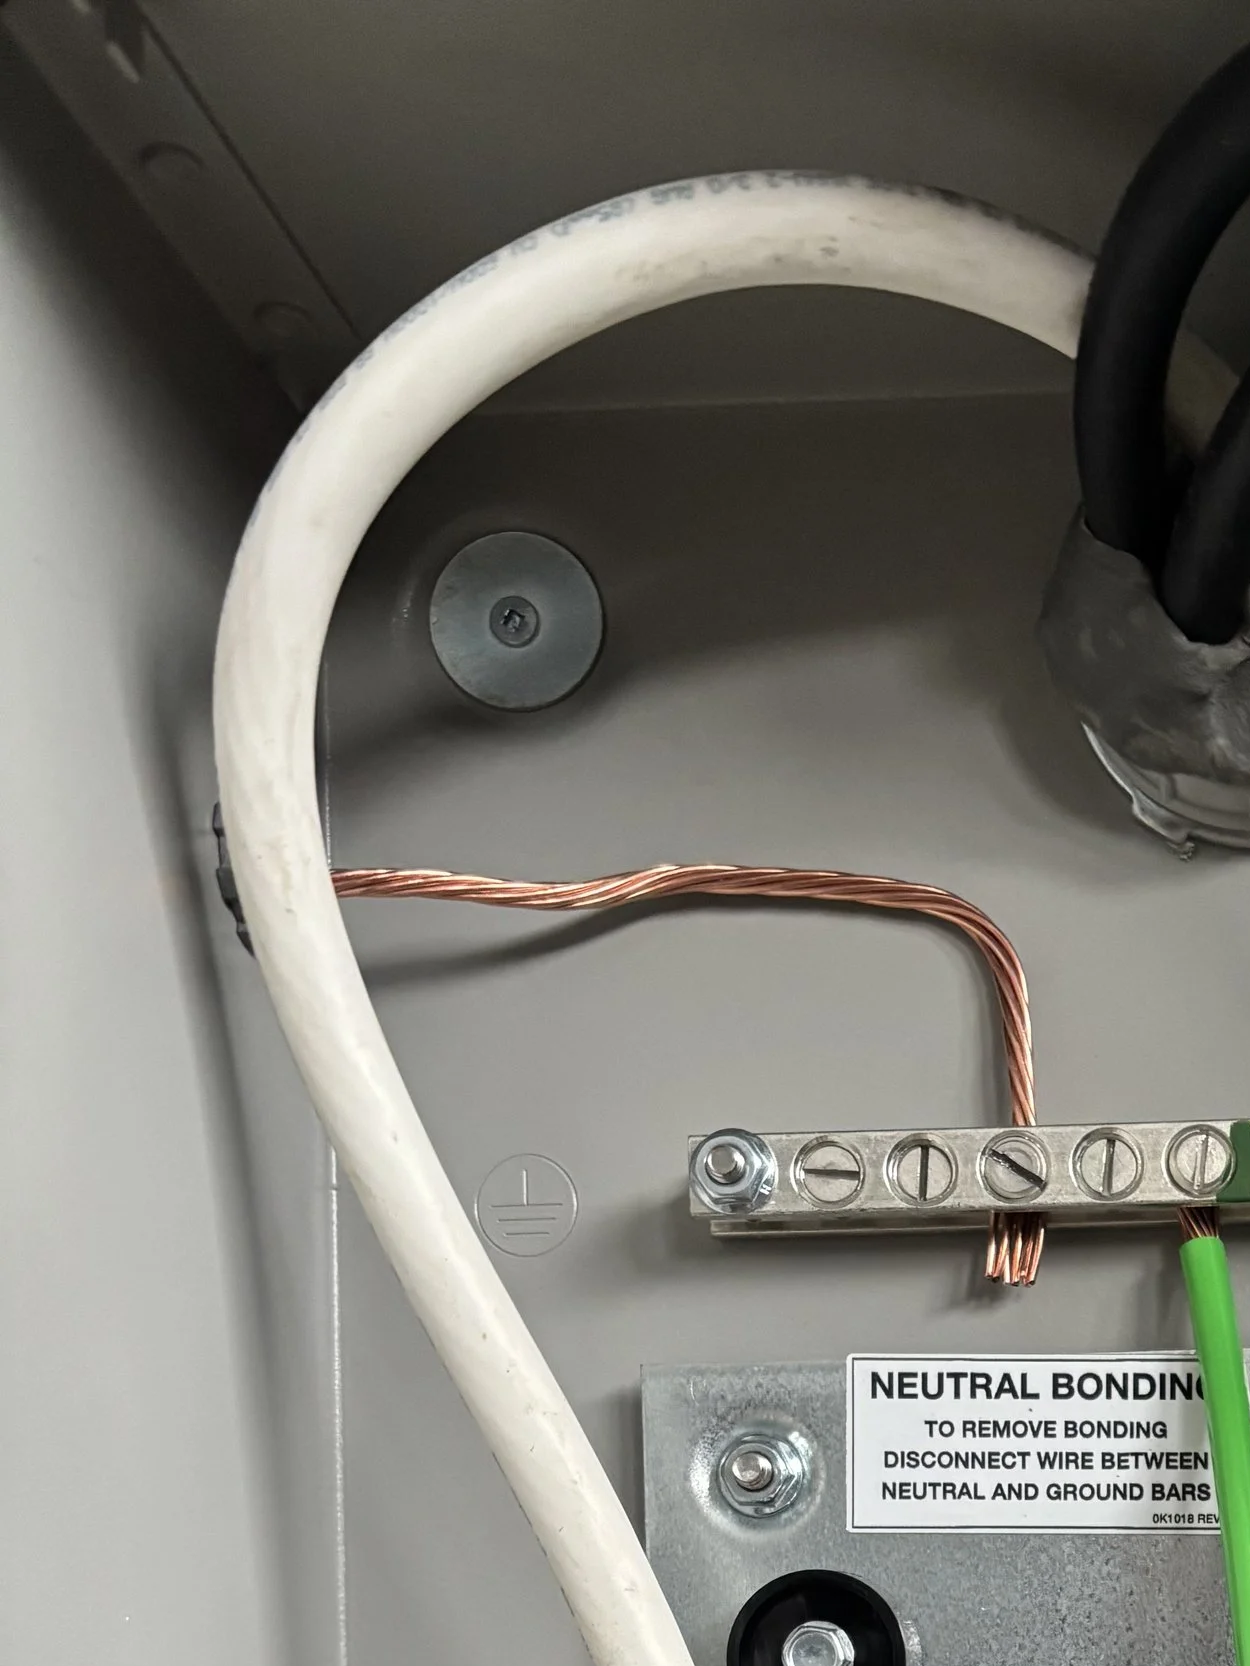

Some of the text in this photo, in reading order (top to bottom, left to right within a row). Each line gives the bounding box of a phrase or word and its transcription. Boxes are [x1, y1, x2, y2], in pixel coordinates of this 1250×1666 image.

[870, 1371, 1205, 1401] NEUTRAL BONDIN
[924, 1420, 1168, 1439] TO REMOVE BONDING
[884, 1450, 1209, 1470] DISCONNECT WIRE BETWEEN
[881, 1482, 1212, 1502] NEUTRAL AND GROUND BARS
